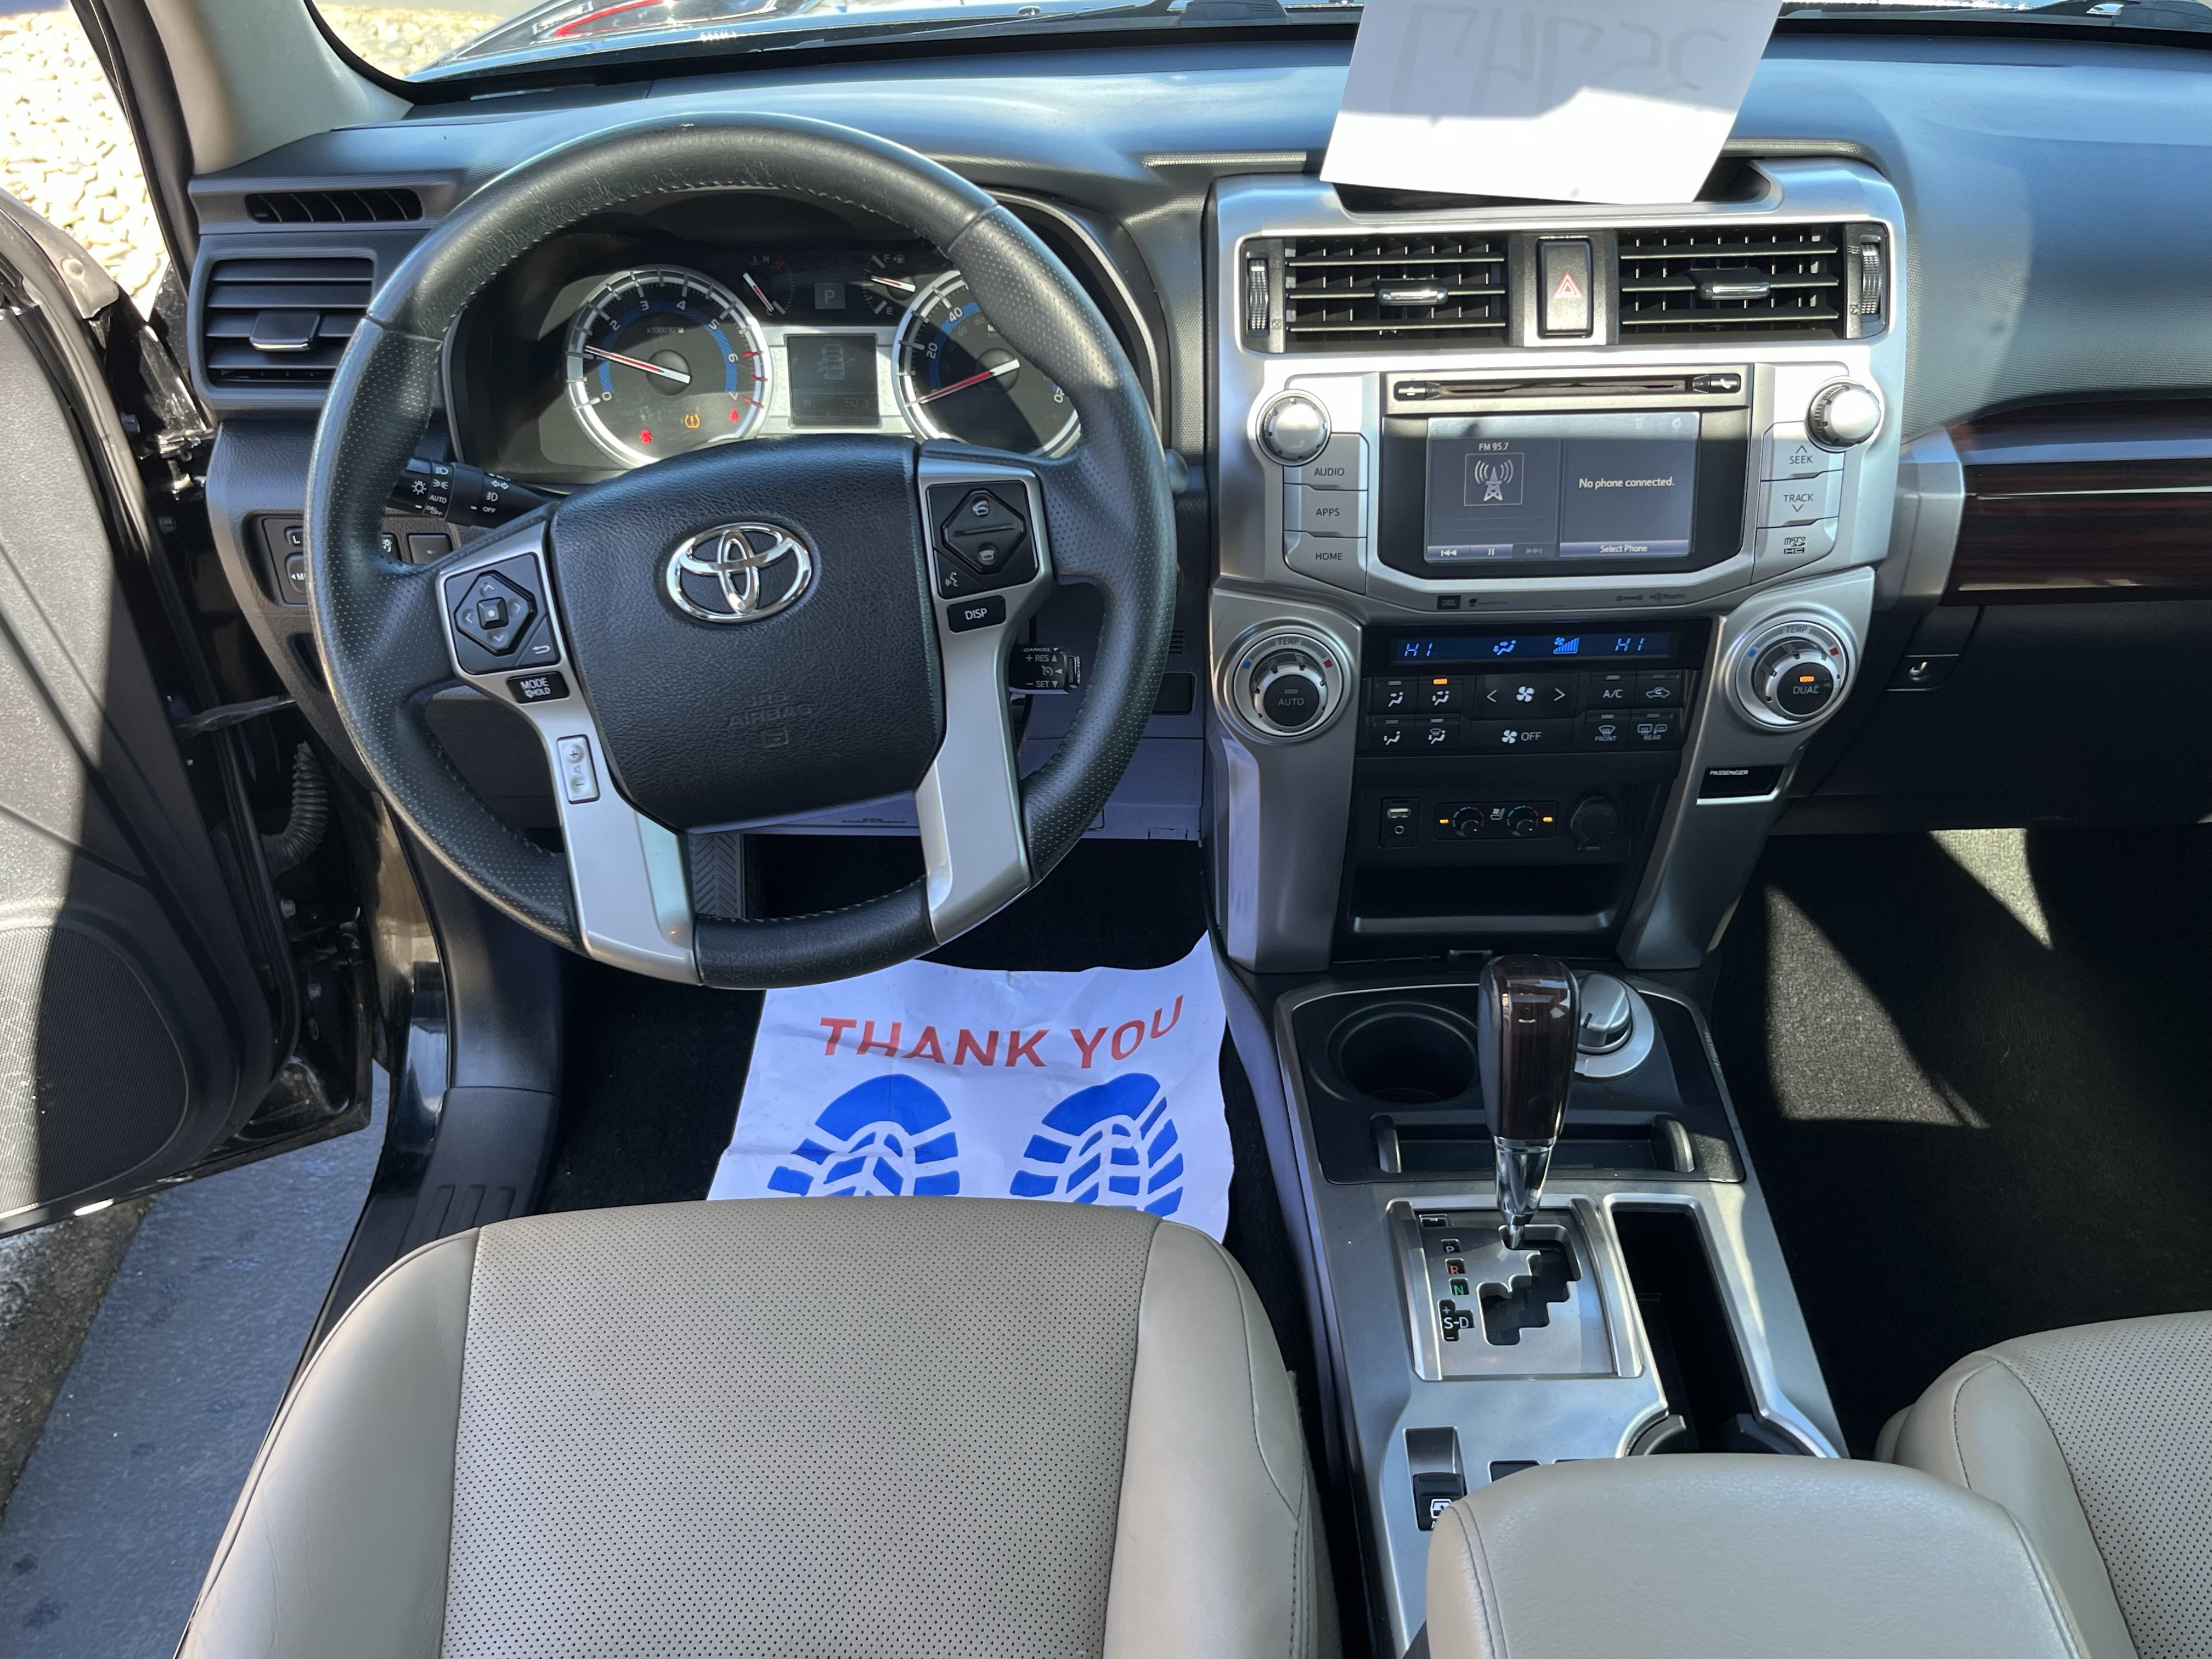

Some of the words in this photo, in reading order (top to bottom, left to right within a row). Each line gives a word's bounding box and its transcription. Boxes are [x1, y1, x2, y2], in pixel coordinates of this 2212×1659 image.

[825, 290, 835, 304] P
[641, 300, 650, 311] 3
[676, 301, 686, 311] 4
[886, 307, 893, 315] E
[949, 307, 963, 322] 40
[609, 320, 621, 331] 2
[709, 318, 721, 330] 5
[926, 342, 938, 359] 20
[728, 353, 739, 363] 6
[602, 391, 612, 402] 0
[1479, 443, 1491, 452] FM
[1492, 442, 1509, 451] 95.7
[1789, 455, 1813, 465] SEEK
[1313, 467, 1345, 477] AUDIO
[1579, 478, 1594, 488] No
[1595, 478, 1624, 490] phone
[1625, 476, 1675, 487] connected.
[428, 494, 447, 505] AUTO
[1783, 493, 1814, 503] TRACK
[482, 506, 496, 514] OFF
[1316, 508, 1340, 518] APPS
[292, 535, 301, 544] L
[1600, 545, 1622, 553] Select
[1623, 544, 1647, 553] Phone
[1316, 552, 1343, 561] HOME
[964, 608, 988, 621] DISP
[1786, 625, 1808, 634] TEMP
[1278, 637, 1299, 646] TEMP
[520, 677, 550, 690] MODE
[1036, 680, 1050, 689] SET
[1602, 689, 1623, 699] A/C
[1793, 685, 1819, 695] DUAL
[1278, 697, 1305, 706] AUTO
[1521, 731, 1542, 741] OFF
[820, 1017, 1050, 1068] THANK
[1070, 994, 1184, 1069] YOU
[1446, 1245, 1454, 1254] P
[1450, 1265, 1459, 1274] R
[1453, 1284, 1464, 1295] N
